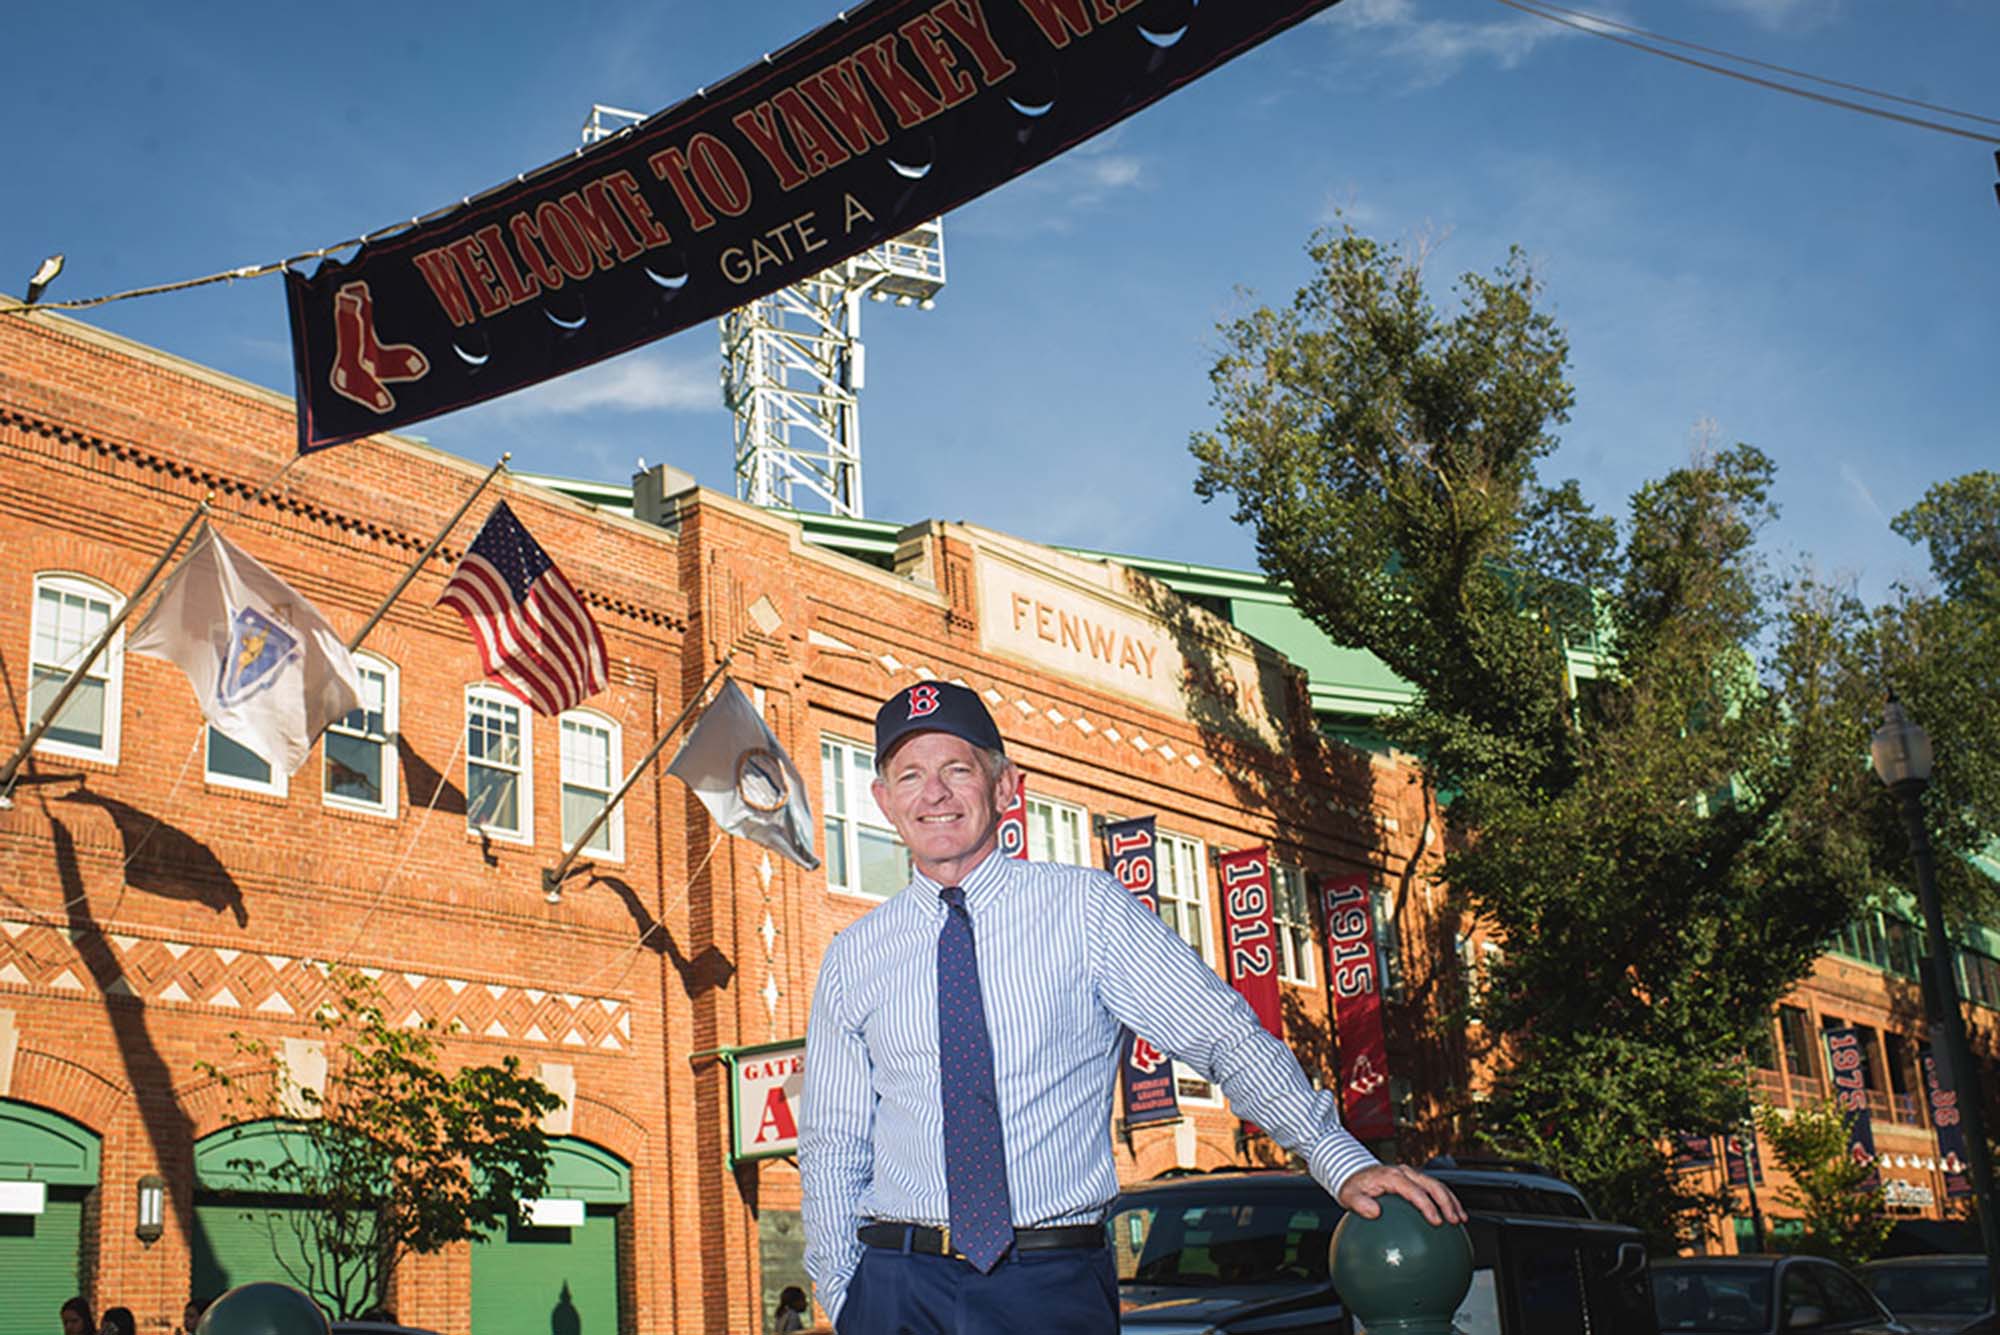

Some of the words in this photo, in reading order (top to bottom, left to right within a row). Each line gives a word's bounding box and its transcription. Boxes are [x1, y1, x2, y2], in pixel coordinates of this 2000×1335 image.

[413, 168, 672, 328] WELCOME
[649, 131, 752, 232] TO
[734, 0, 1016, 192] YAWKEY
[719, 211, 828, 285] GATE
[843, 192, 875, 233] A
[1011, 591, 1158, 680] FENWAY
[907, 684, 941, 721] B
[1113, 829, 1155, 913] 19
[1225, 858, 1272, 980] 1912
[1328, 884, 1373, 998] 1915
[744, 1055, 804, 1080] GATE
[754, 1086, 798, 1143] A
